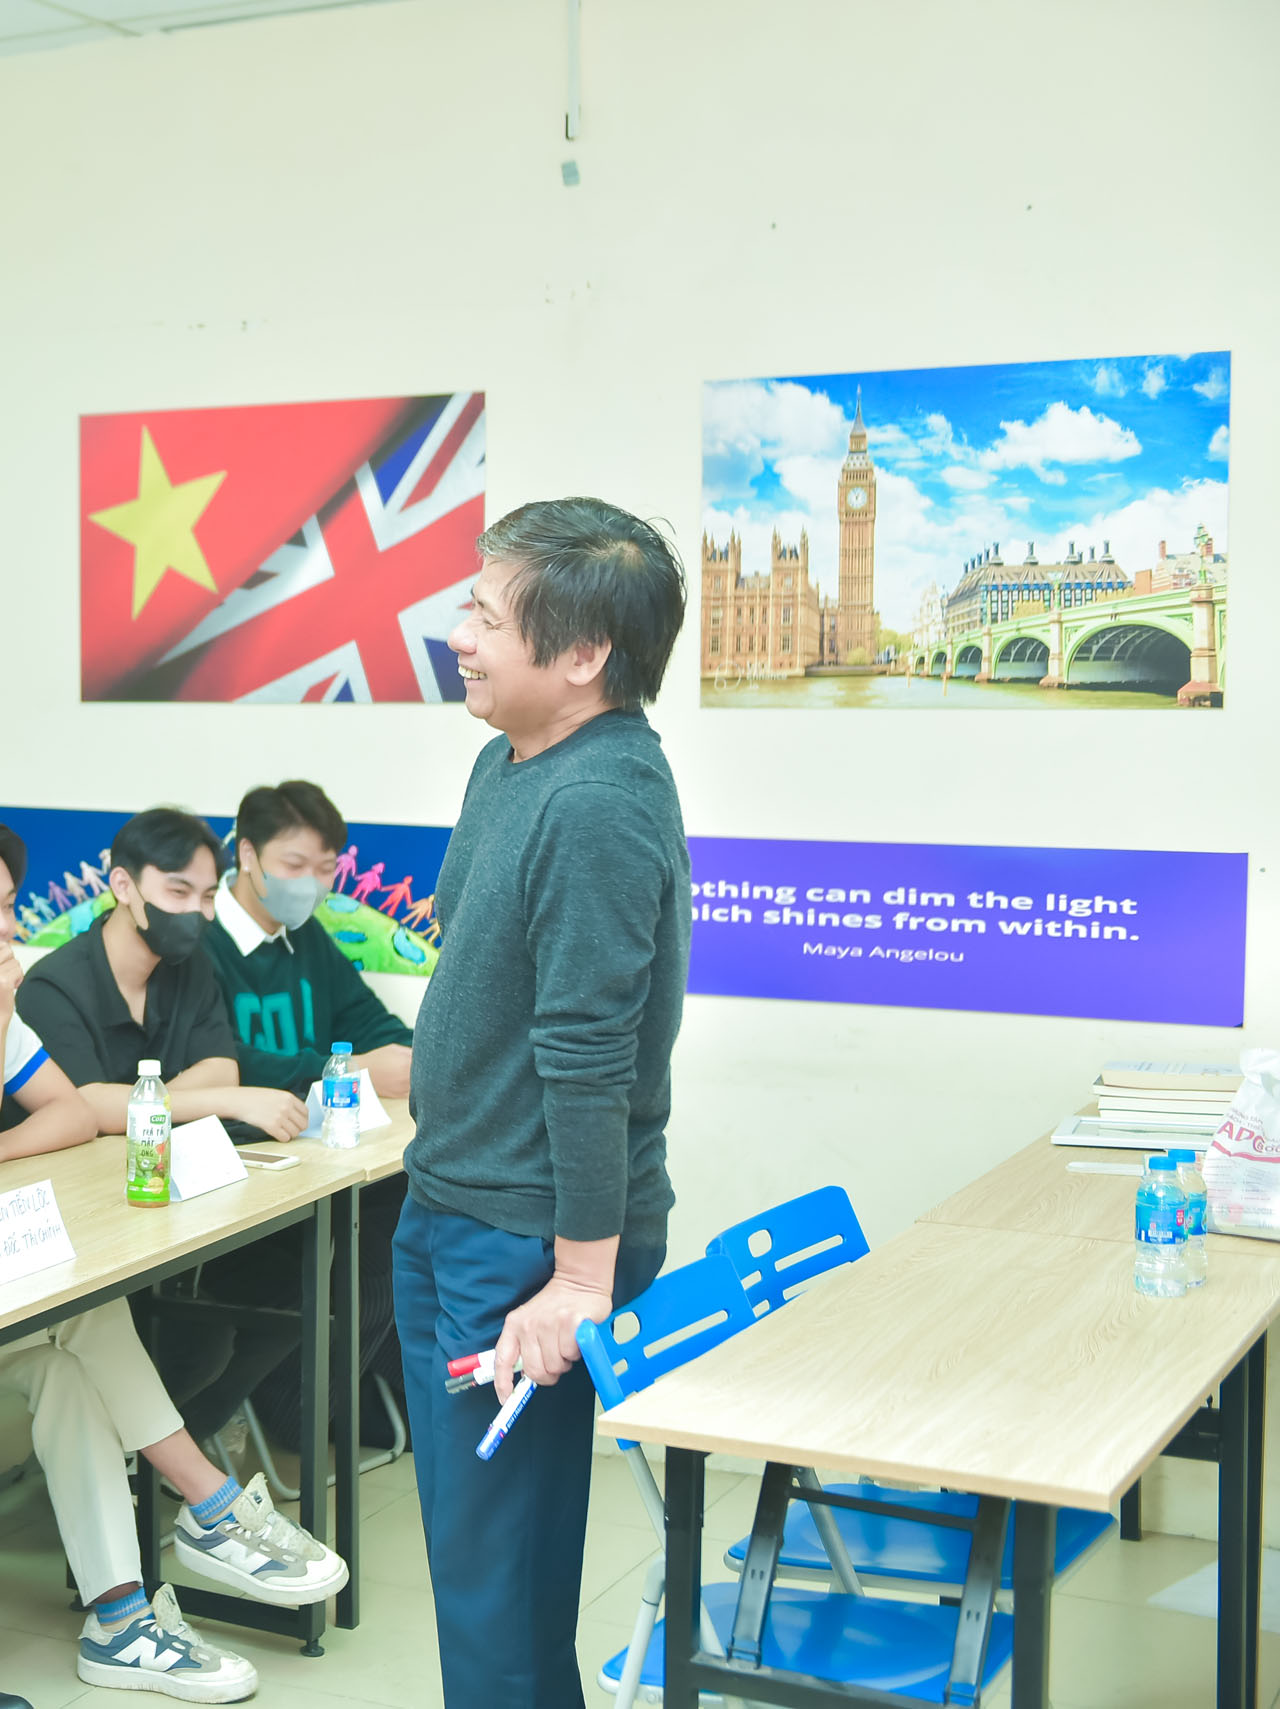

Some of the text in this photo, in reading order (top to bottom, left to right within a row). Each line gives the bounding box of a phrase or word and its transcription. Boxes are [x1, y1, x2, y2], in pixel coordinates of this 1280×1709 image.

[806, 887, 871, 904] can
[883, 886, 956, 908] dim
[967, 890, 1034, 911] the
[1046, 892, 1138, 917] light
[763, 907, 883, 929] shines
[892, 911, 986, 934] from
[998, 918, 1140, 942] within.
[803, 942, 964, 963] Maya Angelou
